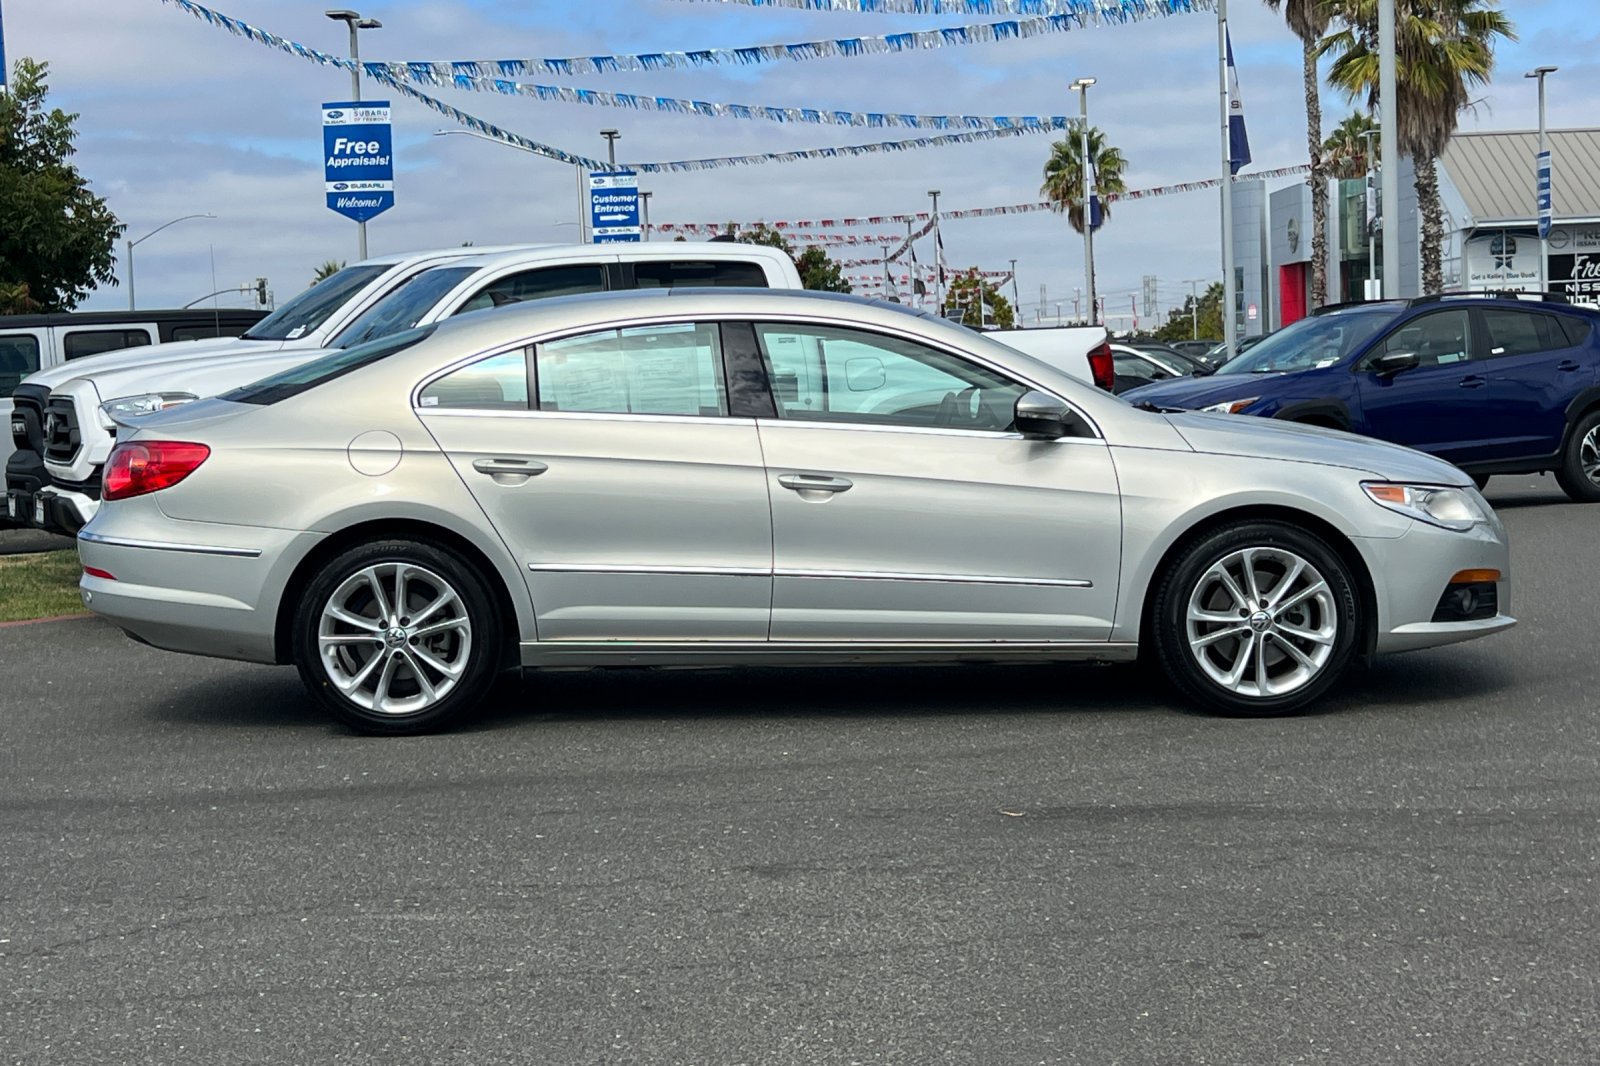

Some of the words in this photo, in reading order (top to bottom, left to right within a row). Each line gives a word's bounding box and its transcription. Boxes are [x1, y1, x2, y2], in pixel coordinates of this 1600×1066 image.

[333, 138, 380, 155] Free
[327, 155, 390, 168] Appraisals!
[336, 196, 383, 208] Welcome!
[592, 195, 637, 204] Customer
[594, 205, 636, 213] Entrance
